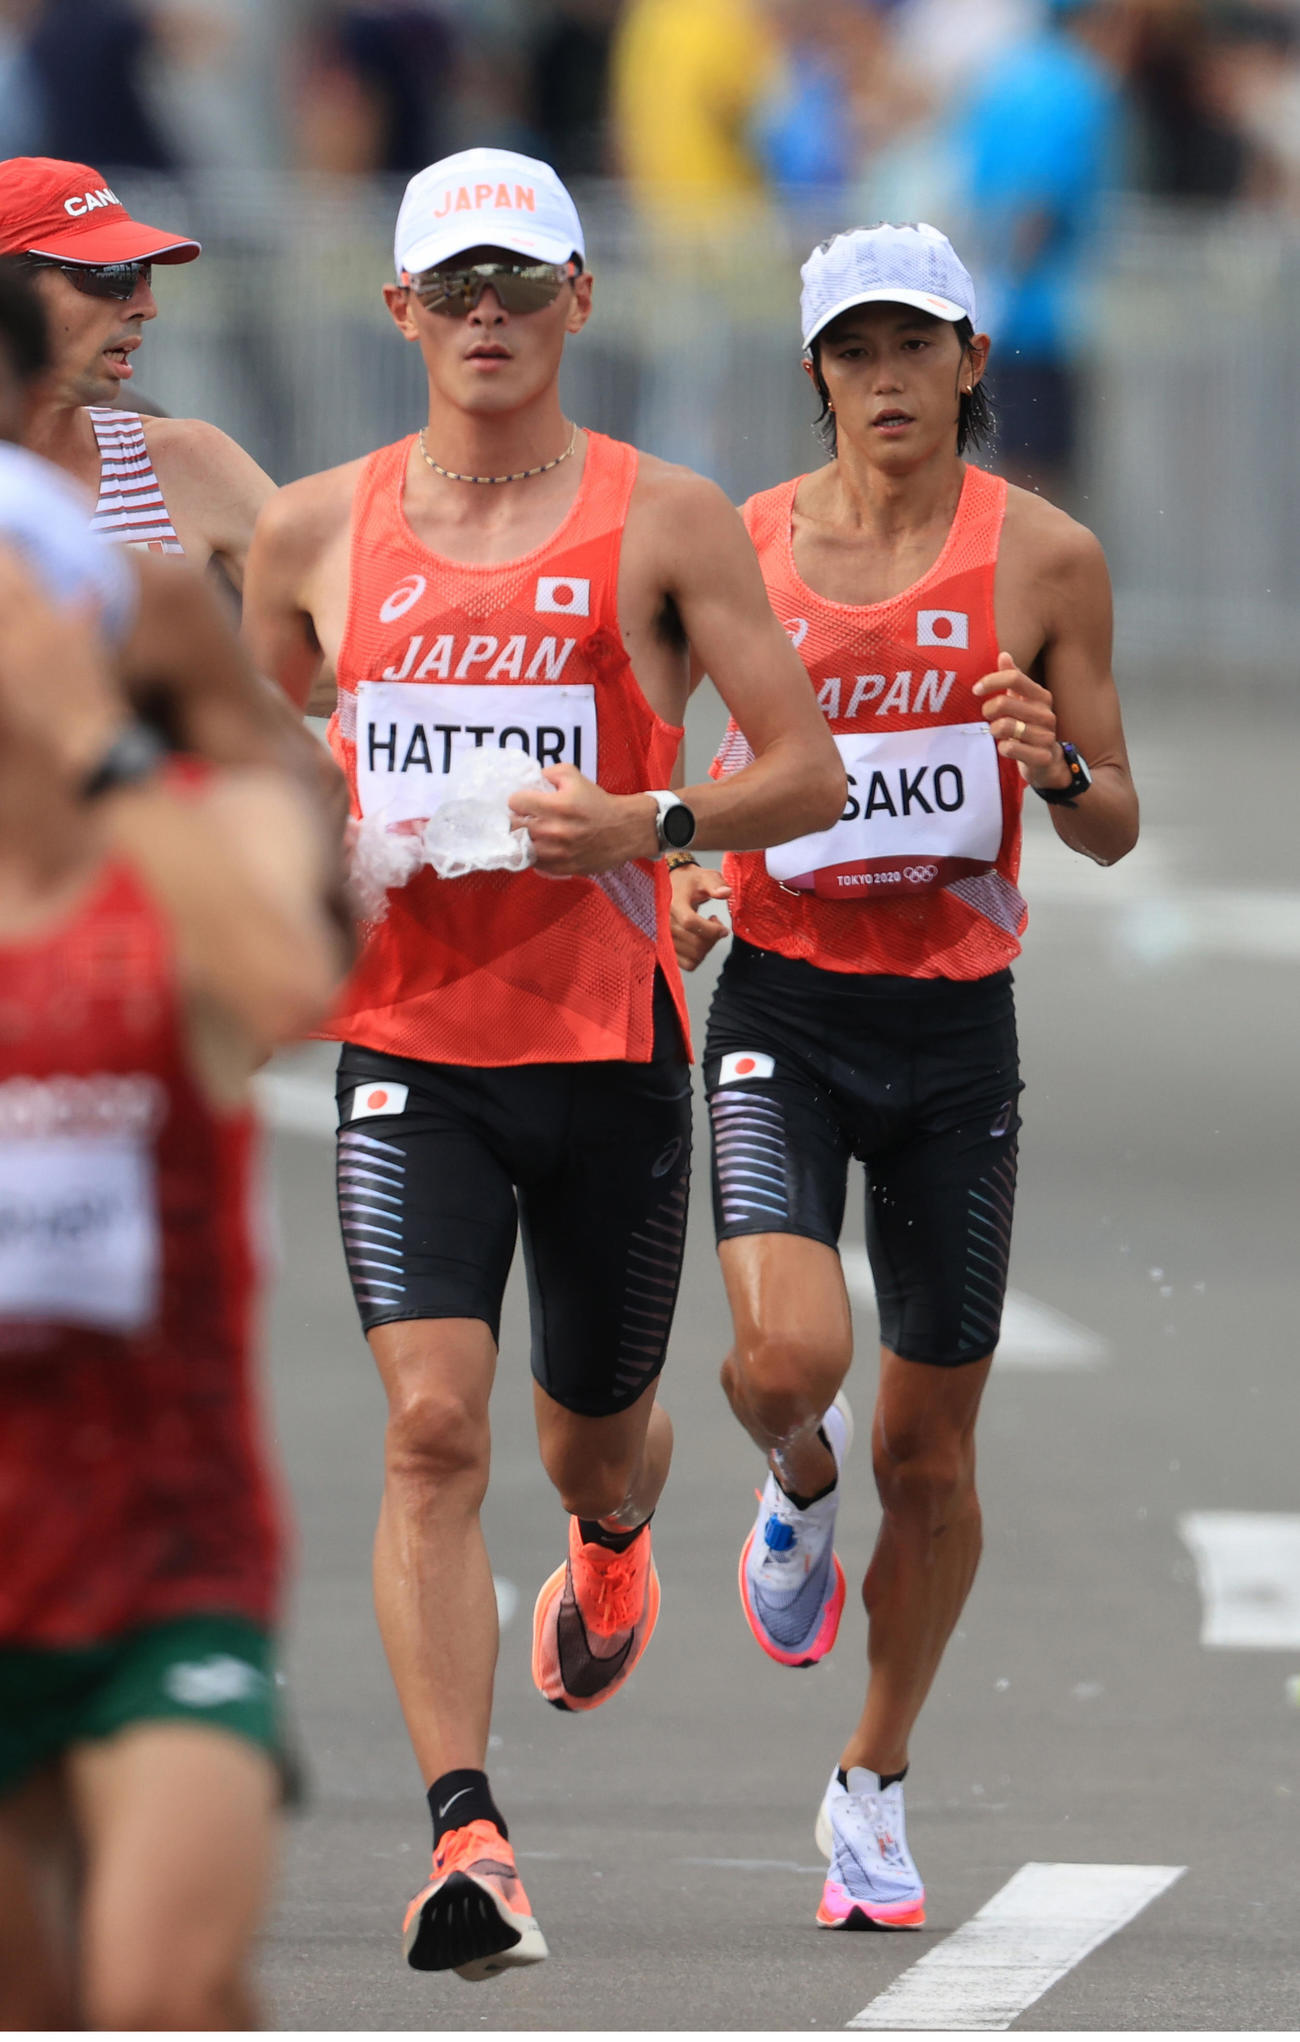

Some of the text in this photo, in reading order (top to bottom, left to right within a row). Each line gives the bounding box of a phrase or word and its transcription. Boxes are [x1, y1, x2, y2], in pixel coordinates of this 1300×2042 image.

[64, 188, 122, 216] CAN
[433, 183, 537, 218] JAPAN
[382, 635, 576, 681] JAPAN
[816, 669, 957, 719] APAN
[840, 764, 964, 821] SAKO
[837, 871, 902, 886] TOKYO 2020
